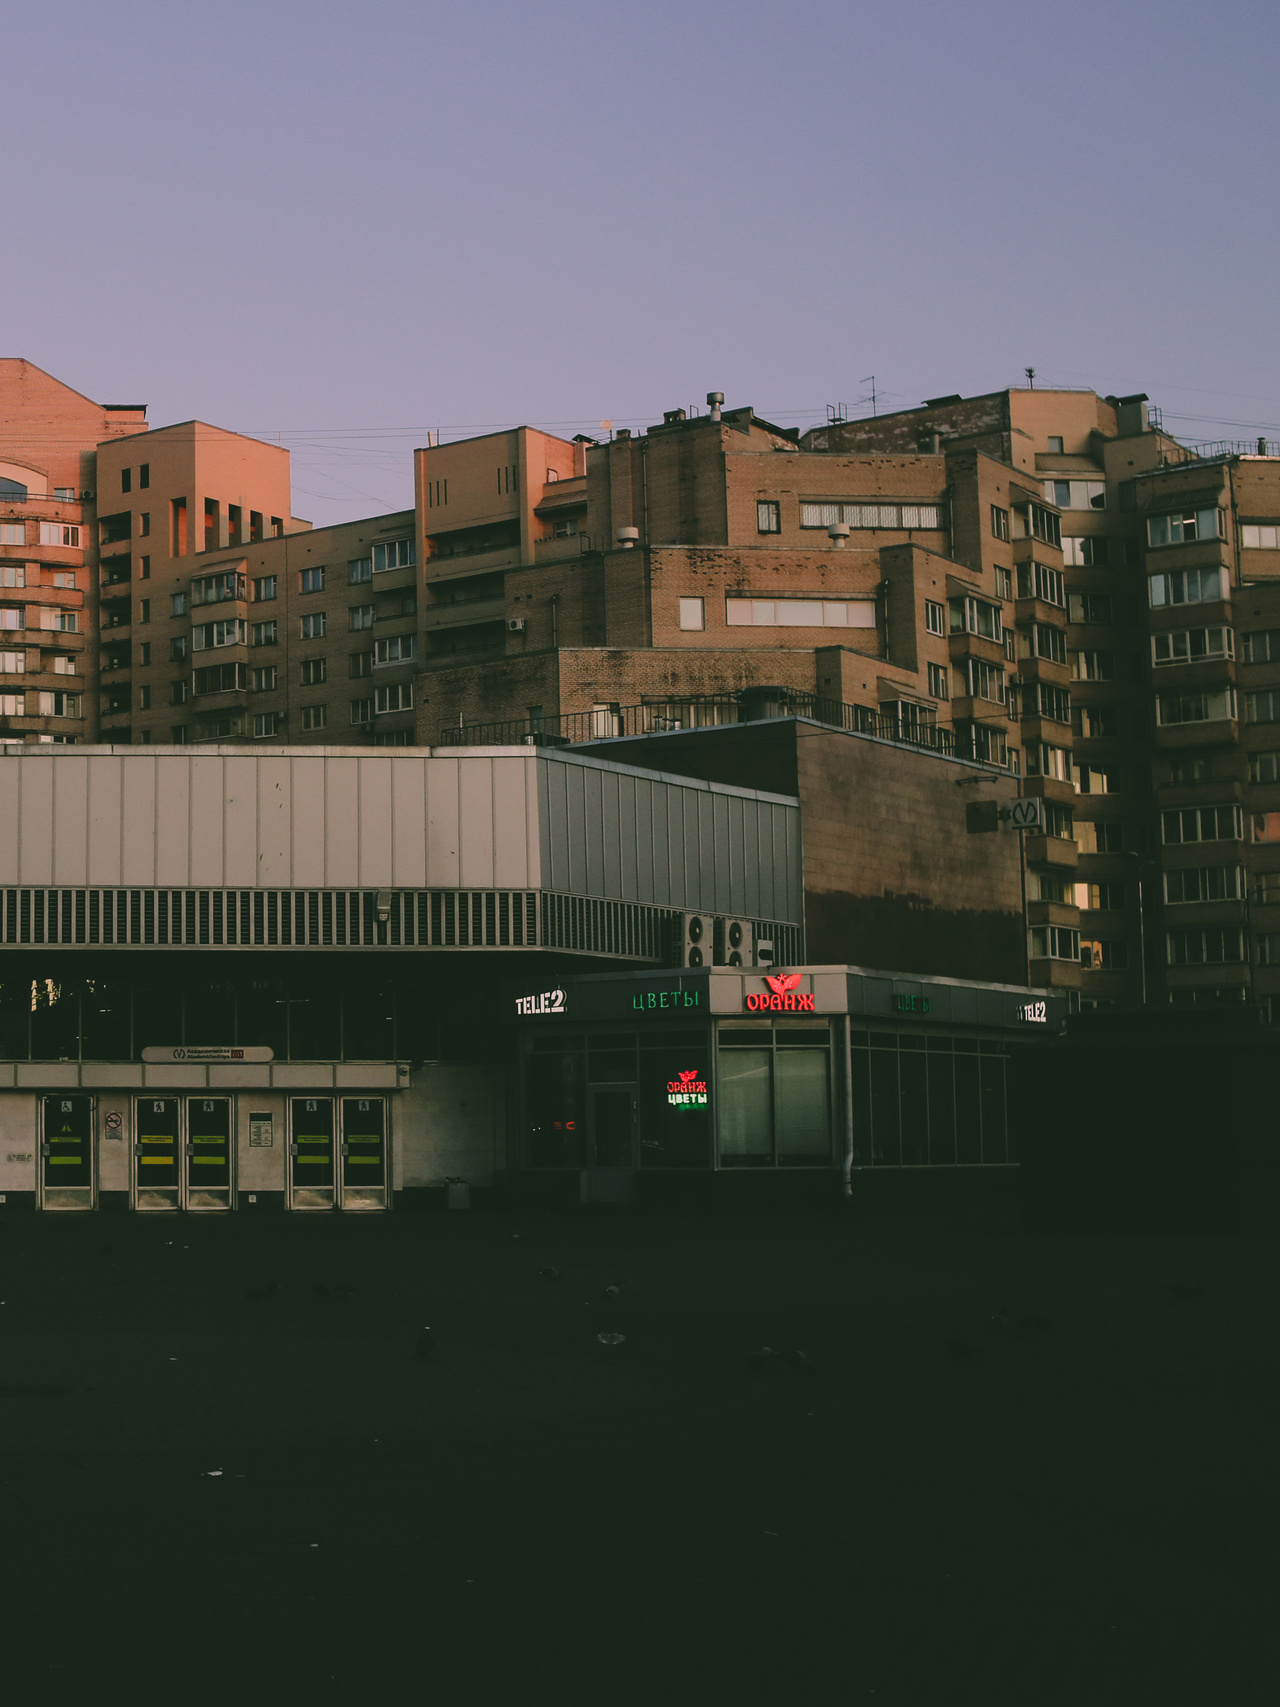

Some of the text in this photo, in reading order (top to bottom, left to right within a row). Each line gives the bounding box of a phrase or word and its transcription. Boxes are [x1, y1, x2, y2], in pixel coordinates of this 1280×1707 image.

[516, 989, 565, 1015] TELE2
[632, 991, 699, 1011] ЦВЕТЫ
[747, 993, 815, 1011] ОРАНЖ
[1024, 1001, 1047, 1022] TELE2
[667, 1082, 707, 1093] ОРАНЖ
[667, 1094, 708, 1105] ЦВЕТЫ
